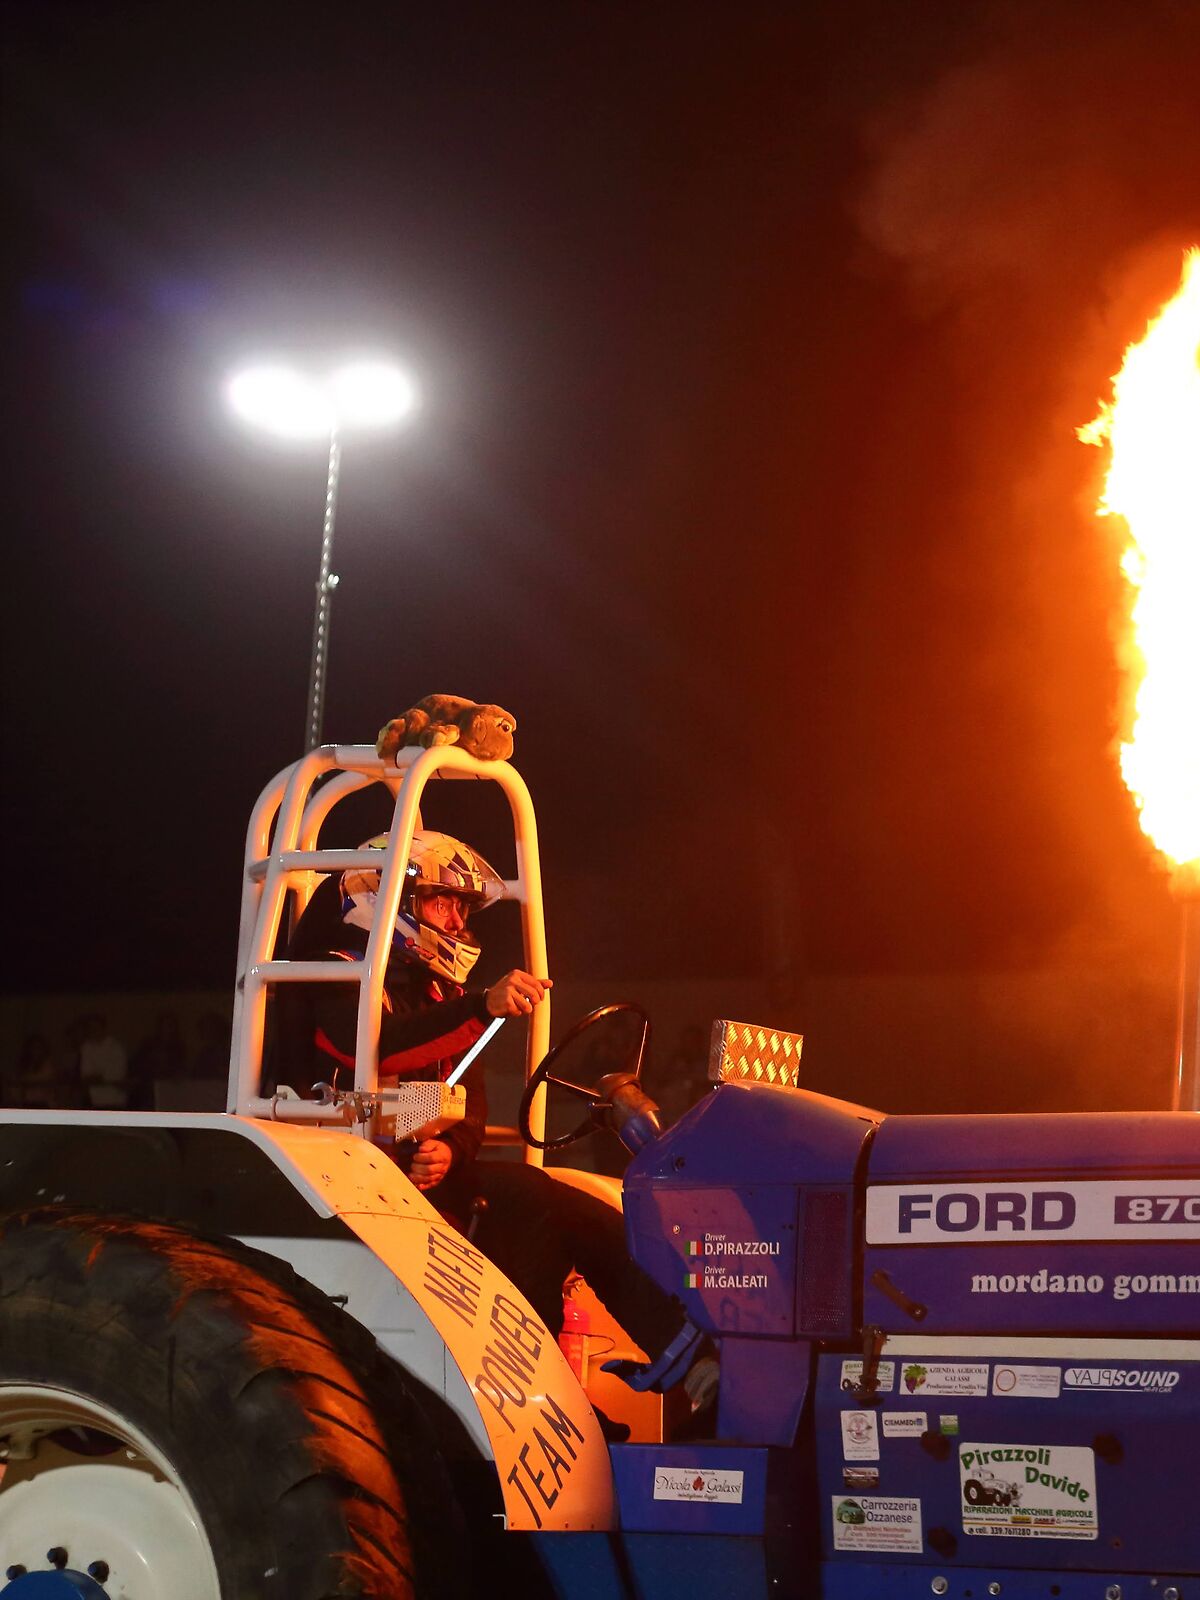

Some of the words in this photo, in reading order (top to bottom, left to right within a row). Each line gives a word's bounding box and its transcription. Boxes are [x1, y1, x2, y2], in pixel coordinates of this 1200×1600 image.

[898, 1191, 1077, 1234] FORD
[704, 1233, 726, 1241] Driver
[704, 1242, 780, 1256] D.PIRAZZOLI
[423, 1226, 484, 1328] NAFTA
[704, 1266, 726, 1274] Driver
[704, 1275, 768, 1288] M.GALEATI
[971, 1269, 1104, 1293] mordano
[473, 1293, 546, 1433] POWER
[1114, 1370, 1180, 1387] SOUND
[506, 1392, 585, 1529] TEAM
[960, 1447, 1051, 1470] Pirazzoli
[655, 1475, 691, 1491] Nicola
[706, 1477, 742, 1494] Galassi
[1025, 1466, 1090, 1502] Davide
[861, 1499, 918, 1511] Carrozzeria
[963, 1505, 1013, 1515] RIPARAZIONI
[1015, 1507, 1054, 1516] MACCHINE
[1055, 1508, 1093, 1518] AGRICOLE
[866, 1511, 913, 1523] Ozzanese
